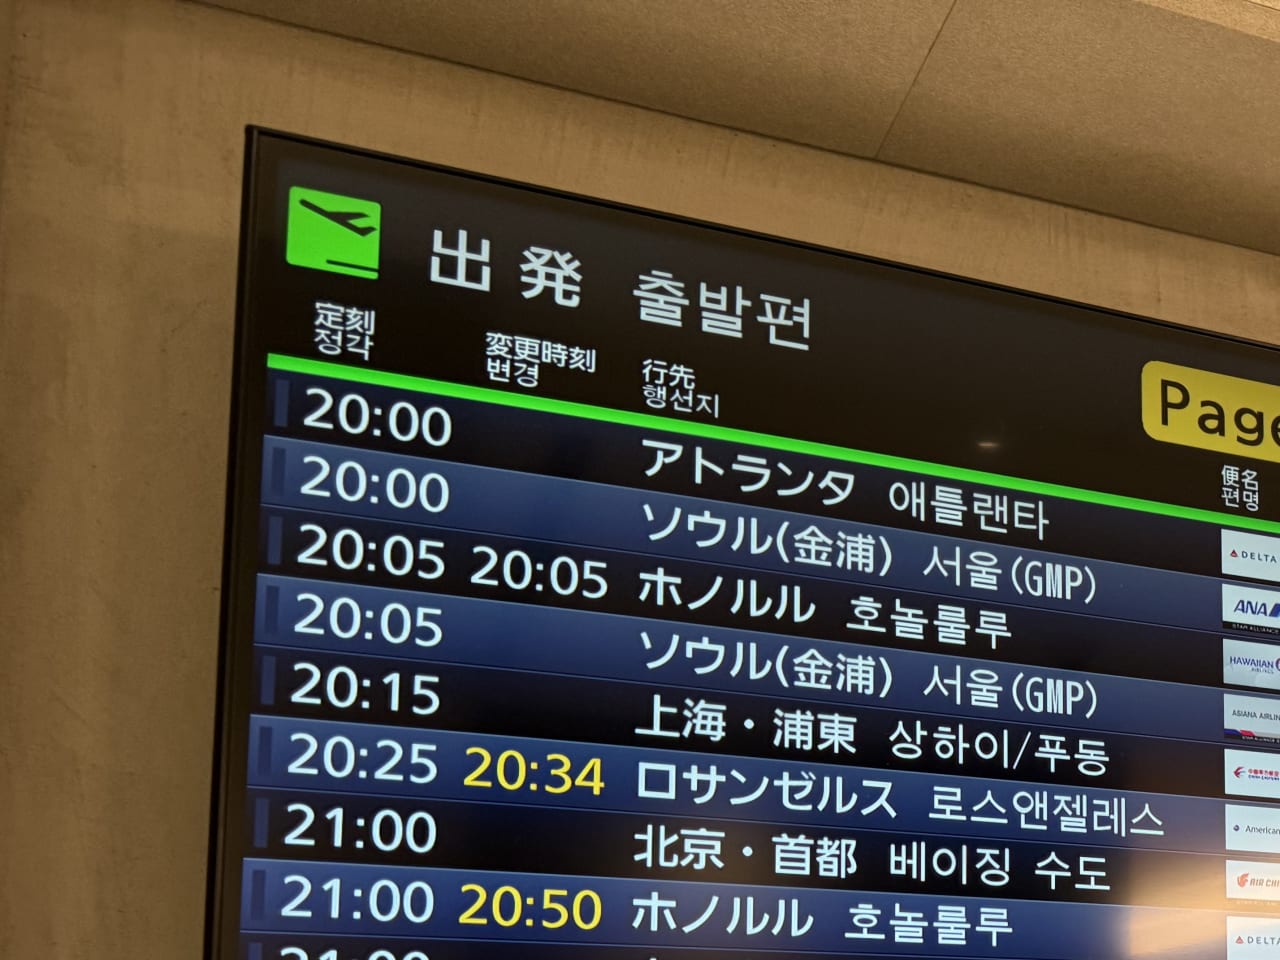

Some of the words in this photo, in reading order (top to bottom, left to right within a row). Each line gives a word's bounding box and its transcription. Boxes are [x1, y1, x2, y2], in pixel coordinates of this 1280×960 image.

[430, 228, 583, 308] 出発
[315, 302, 376, 335] 定刻
[633, 270, 811, 350] 출발편
[314, 330, 374, 360] 정각
[486, 333, 596, 373] 変更時刻
[486, 357, 539, 387] 변경
[642, 360, 695, 390] 行先
[303, 387, 452, 447] 20:00
[642, 384, 720, 419] 행선지
[300, 455, 449, 513] 20:00
[642, 439, 855, 506] アトランタ
[1221, 465, 1259, 491] 便名
[889, 481, 1050, 541] 애틀랜타
[1221, 487, 1259, 512] 편명
[297, 523, 445, 580] 20:05
[643, 503, 892, 577] ソウル(金浦)
[1242, 551, 1276, 563] DELTA
[471, 545, 608, 599] 20:05
[638, 567, 816, 623] ホノルル
[294, 592, 443, 647] 20:05
[845, 596, 1012, 650] 호놀룰루
[1234, 599, 1267, 616] ANA
[290, 662, 440, 715] 20:15
[641, 632, 893, 699] ソウル(金浦)
[634, 693, 857, 754] 上海・浦東
[888, 720, 1110, 777] 상하이/푸동
[287, 732, 438, 785] 20:25
[464, 746, 606, 795] 20:34
[637, 761, 897, 818] ロサンゼルス
[929, 785, 1165, 838] 로스앤젤레스
[284, 803, 437, 854] 21:00
[633, 823, 857, 879] 北京・首都
[1246, 825, 1280, 835] American
[889, 841, 1010, 887] 베이징
[1034, 850, 1111, 891] 수도
[281, 875, 435, 923] 21:00
[459, 883, 602, 931] 20:50
[632, 891, 814, 937] ホノルル
[844, 903, 1013, 947] 호놀룰루
